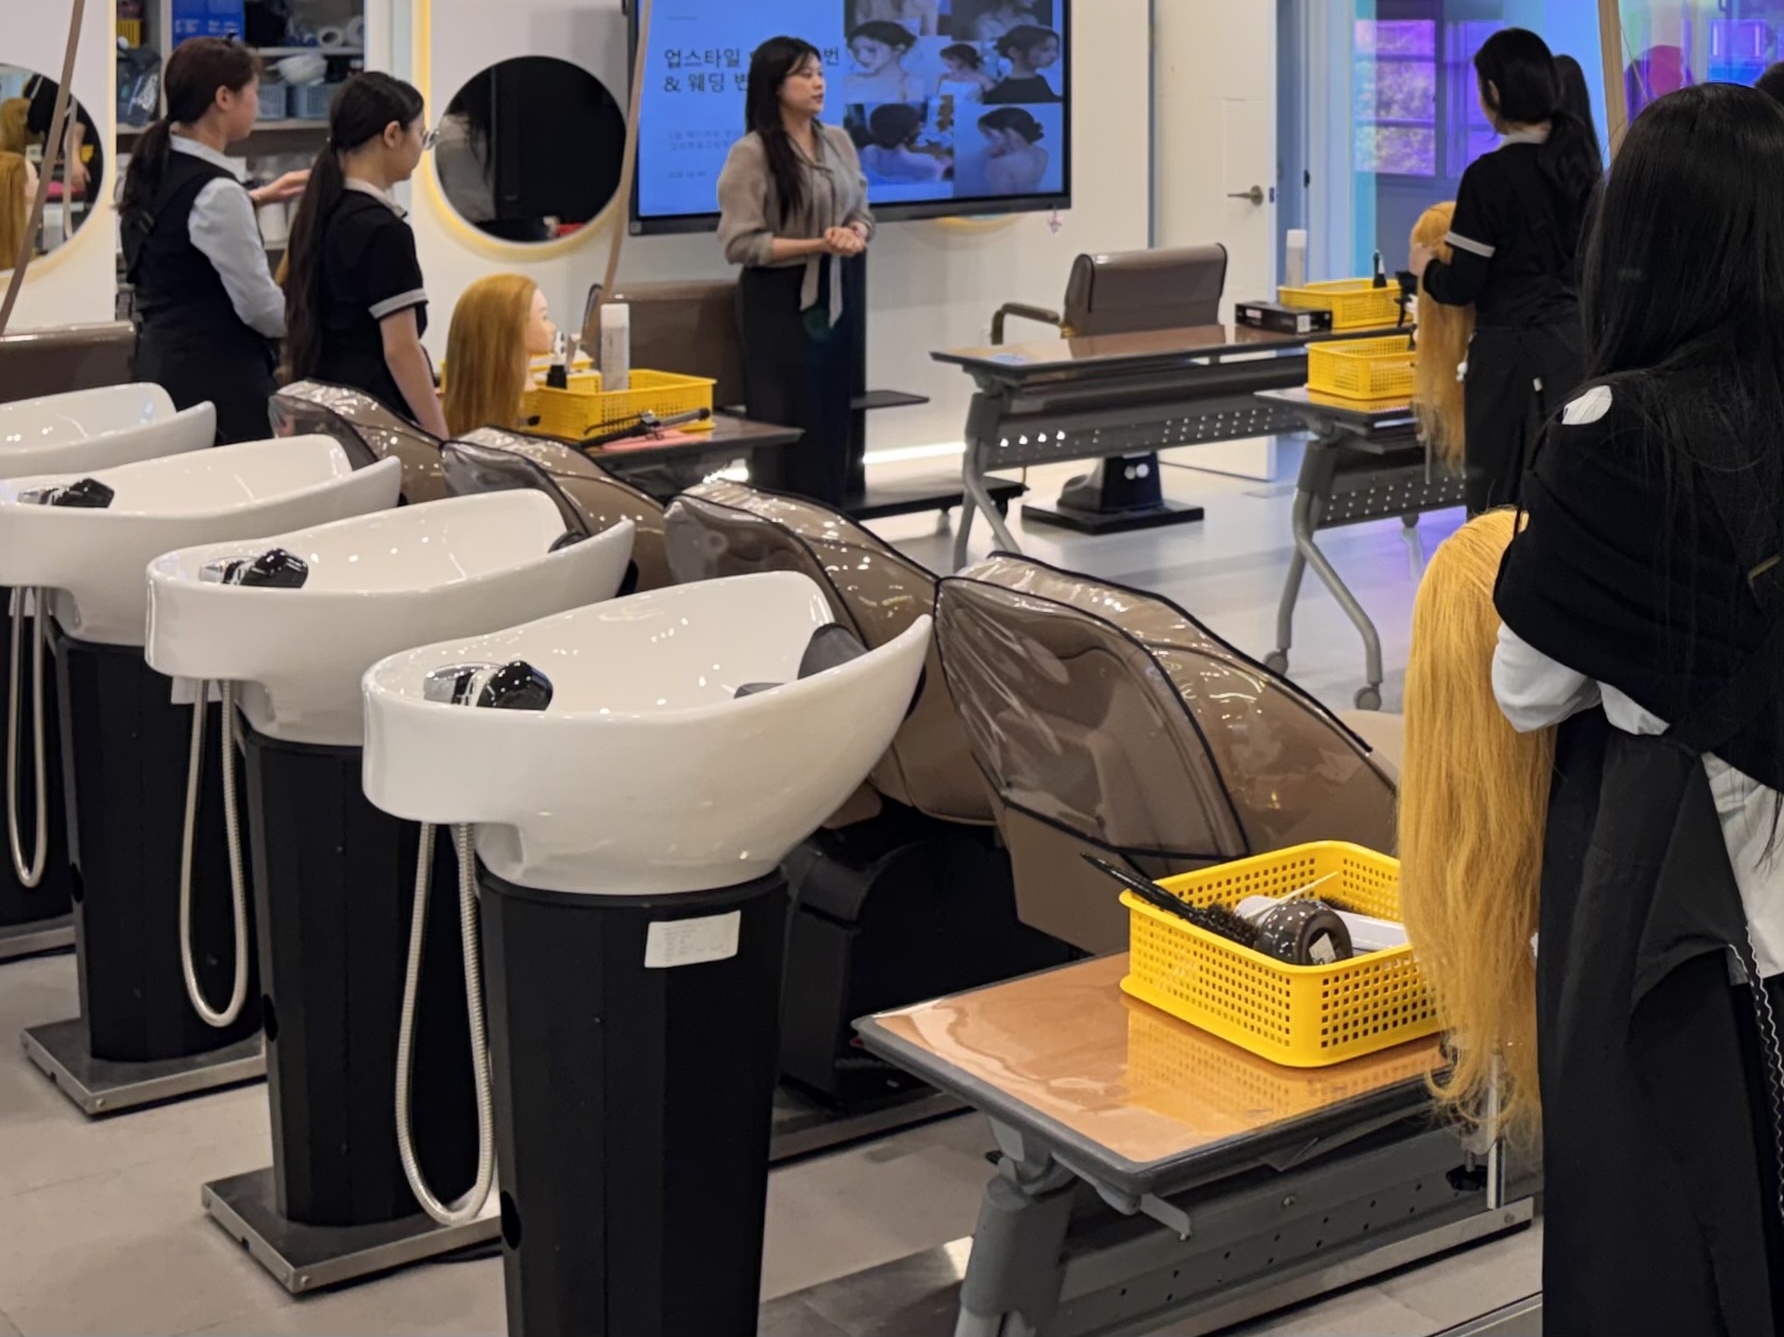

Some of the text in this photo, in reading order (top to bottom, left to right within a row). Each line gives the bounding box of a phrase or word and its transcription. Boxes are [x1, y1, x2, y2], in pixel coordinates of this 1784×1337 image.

[664, 48, 741, 69] 업스타일
[664, 76, 681, 93] &
[687, 73, 725, 93] 웨딩
